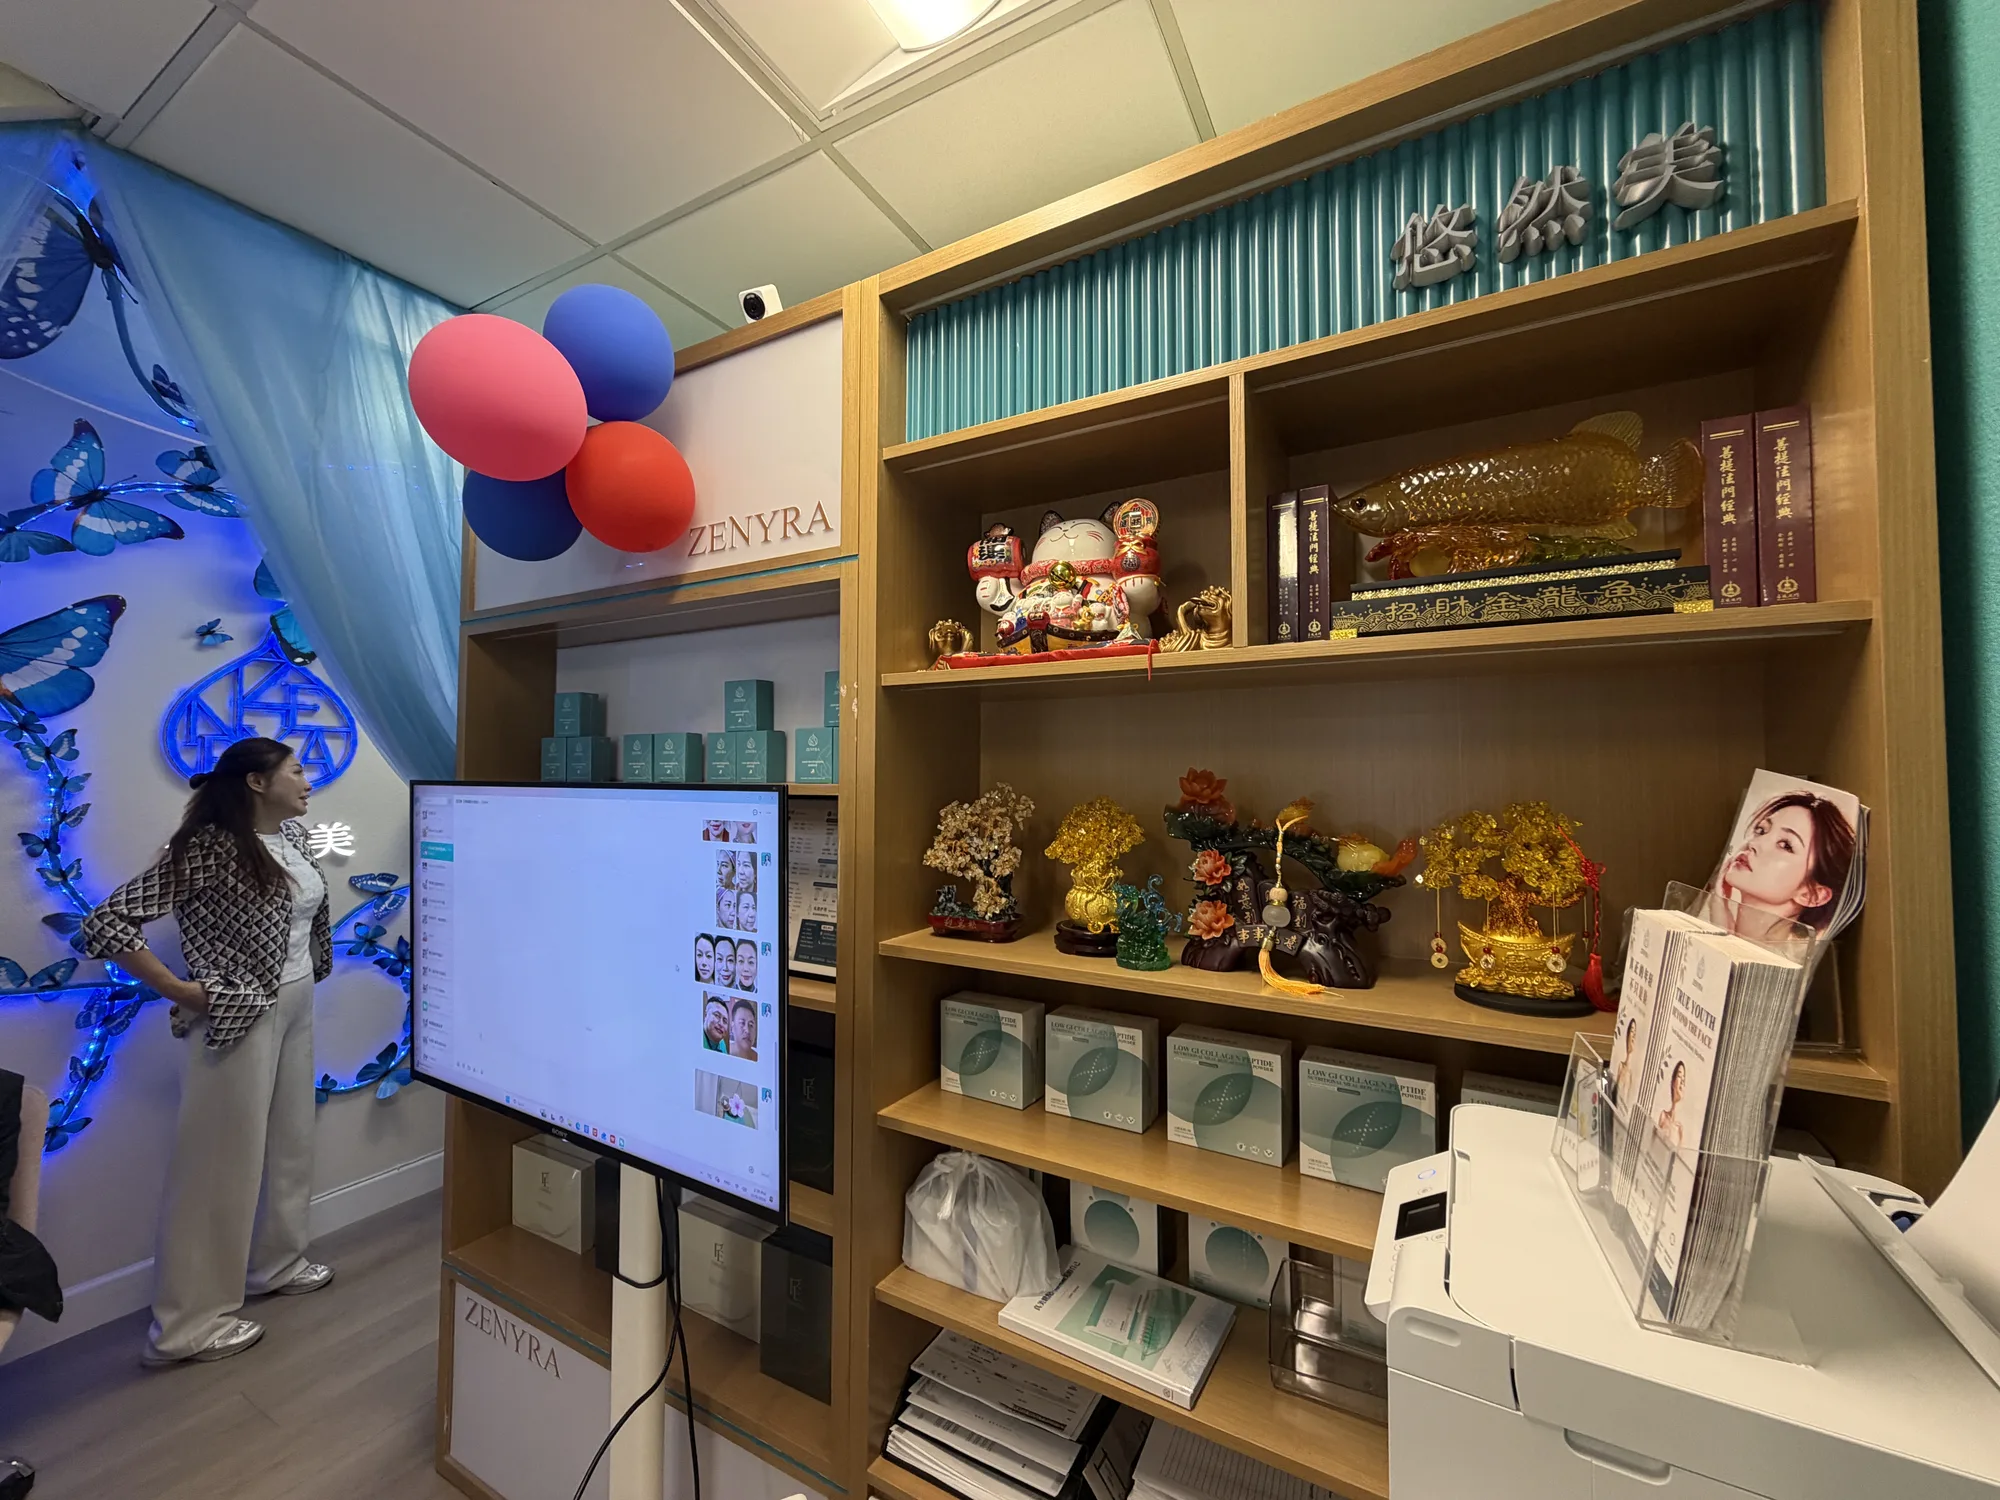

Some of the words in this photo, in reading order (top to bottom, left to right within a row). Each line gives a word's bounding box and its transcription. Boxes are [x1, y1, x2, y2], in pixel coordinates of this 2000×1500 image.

[1390, 121, 1724, 291] 悠然美
[687, 500, 835, 558] ZENYRA
[1385, 578, 1637, 623] 招財金龍魚
[307, 822, 356, 858] 美
[1675, 986, 1691, 1011] TRUE
[1691, 999, 1716, 1032] YOUTH
[1688, 1019, 1698, 1037] THE
[1697, 1028, 1713, 1050] FACE
[1173, 1044, 1190, 1052] LOW
[1200, 1049, 1240, 1061] COLLAGEN
[1241, 1056, 1275, 1067] PEPTIDE
[1307, 1068, 1326, 1077] LOW
[1339, 1074, 1387, 1088] COLLAGEN
[1388, 1083, 1427, 1096] PEPTIDE
[1401, 1092, 1427, 1101] POWDER
[465, 1296, 561, 1380] ZENYRA
